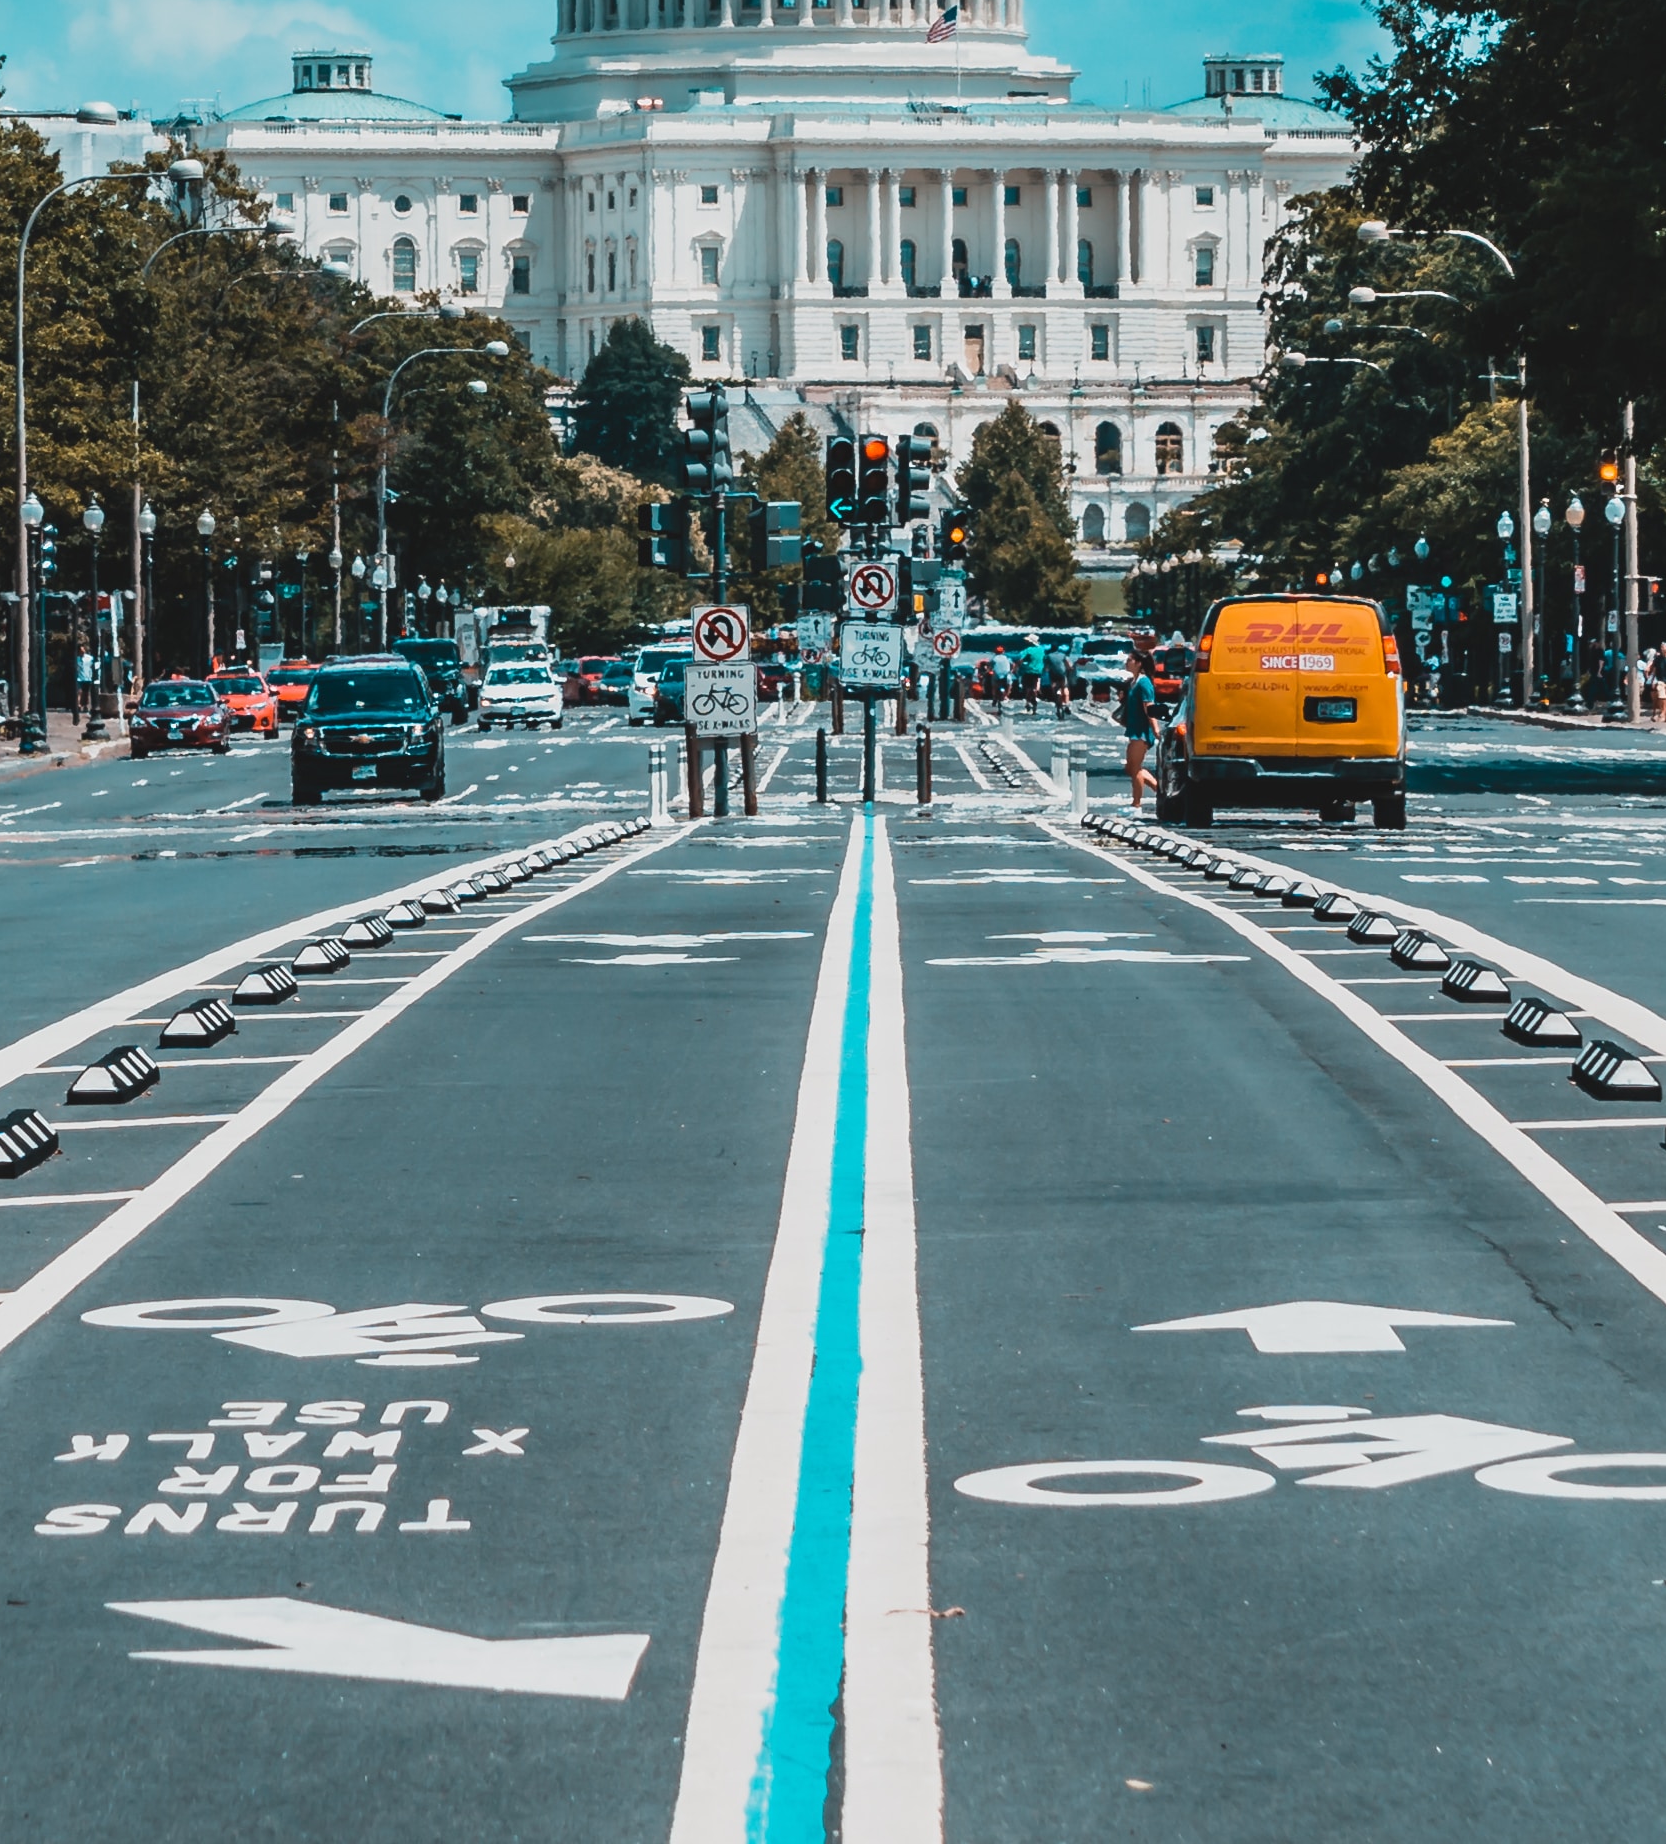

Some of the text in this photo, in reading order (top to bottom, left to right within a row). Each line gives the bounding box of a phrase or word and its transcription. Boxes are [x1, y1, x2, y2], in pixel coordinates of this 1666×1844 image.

[854, 630, 890, 642] TURNING
[1245, 623, 1350, 644] DHL
[1261, 655, 1332, 669] SINCE 1969
[697, 669, 744, 679] TURNING
[862, 668, 898, 679] X-WALKS
[713, 719, 750, 731] X-WALKS
[207, 1399, 450, 1427] USE
[53, 1427, 530, 1461] X WALK
[157, 1463, 398, 1495] FOR
[33, 1498, 472, 1535] TURNS
